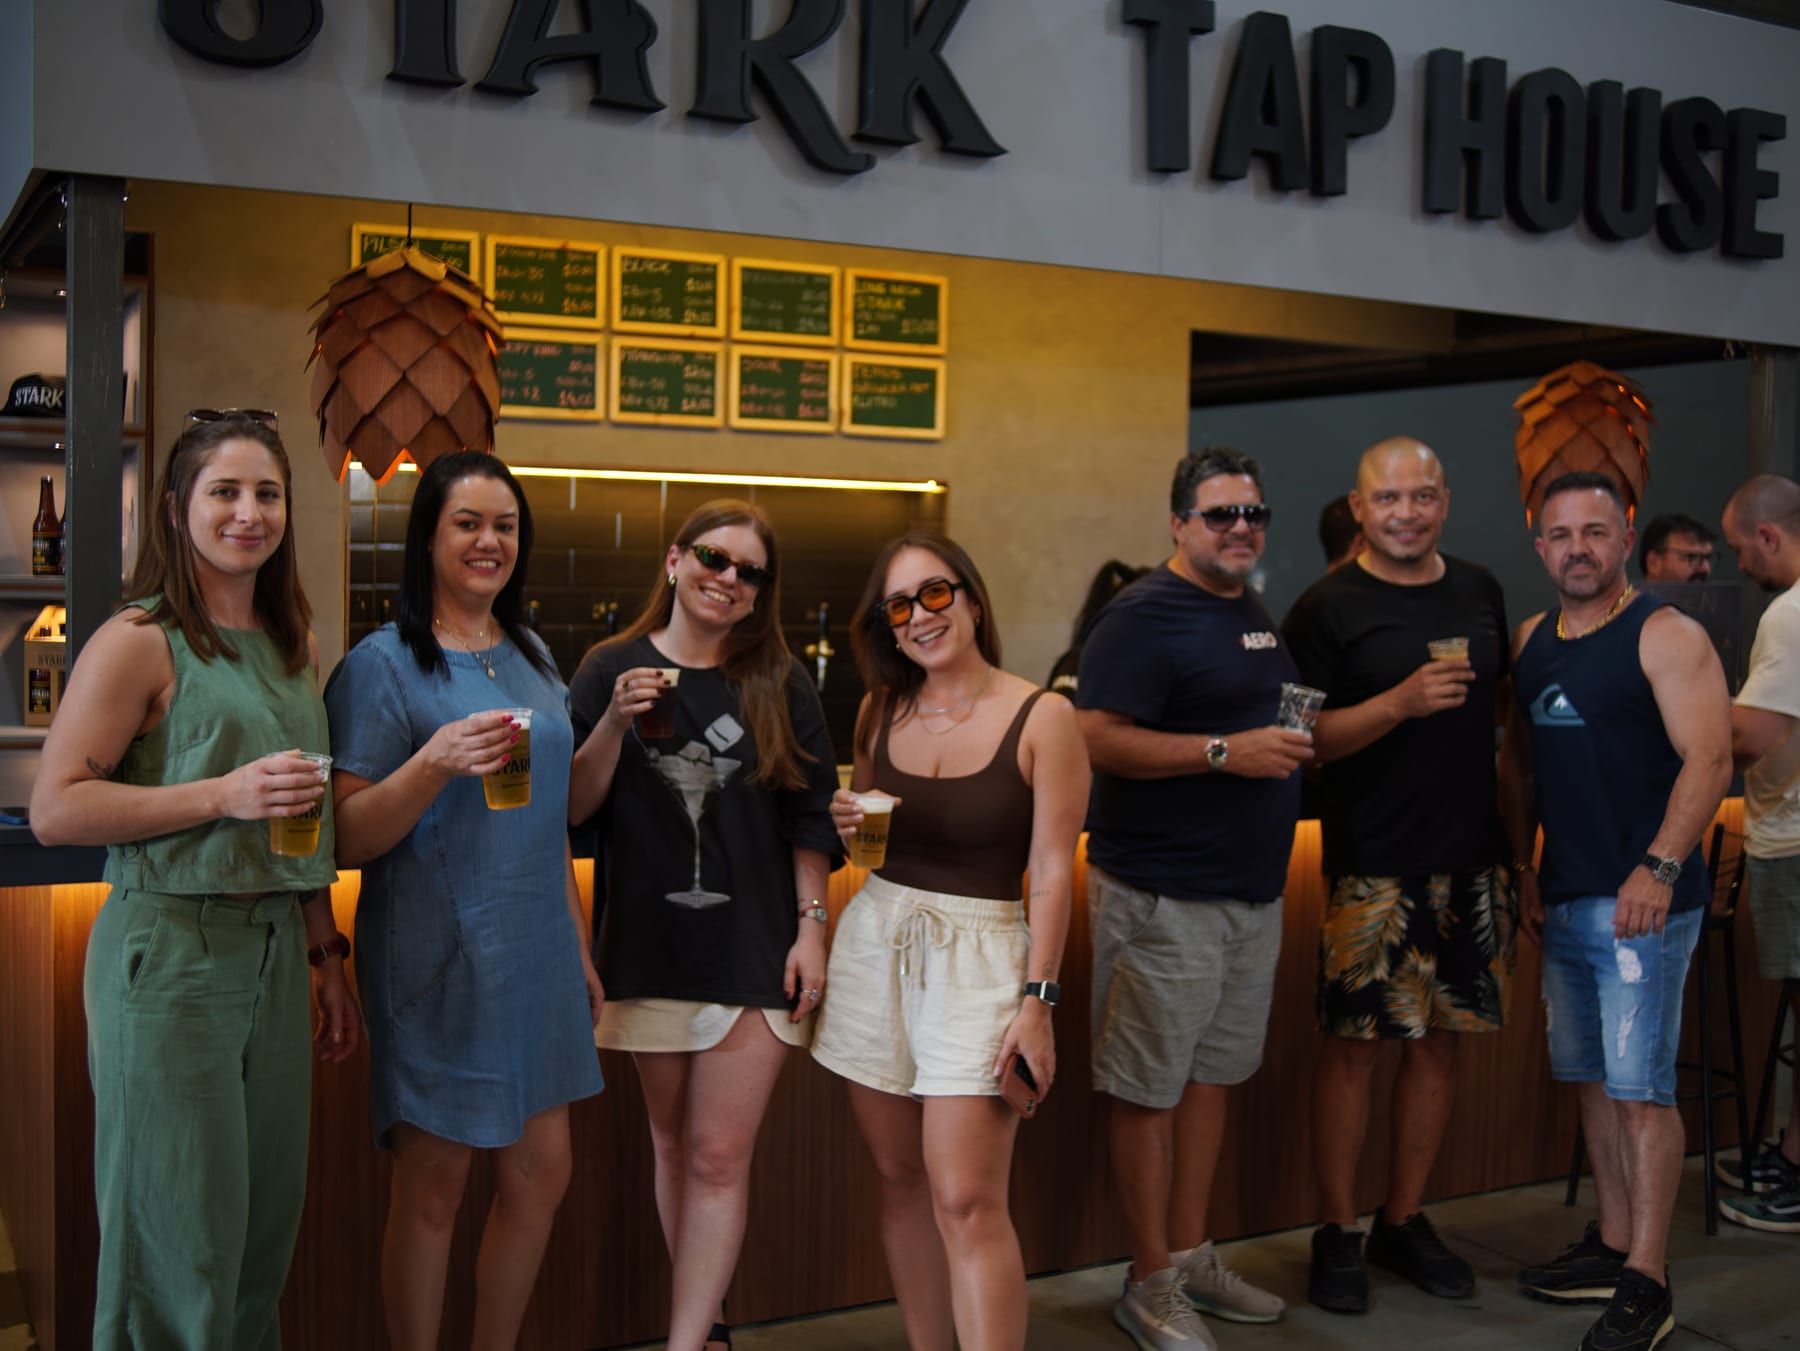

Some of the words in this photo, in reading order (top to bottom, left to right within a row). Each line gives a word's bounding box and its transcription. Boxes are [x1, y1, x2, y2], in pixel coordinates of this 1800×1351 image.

[1123, 0, 1396, 196] TAP
[1421, 47, 1787, 259] HOUSE
[15, 386, 64, 409] STARK
